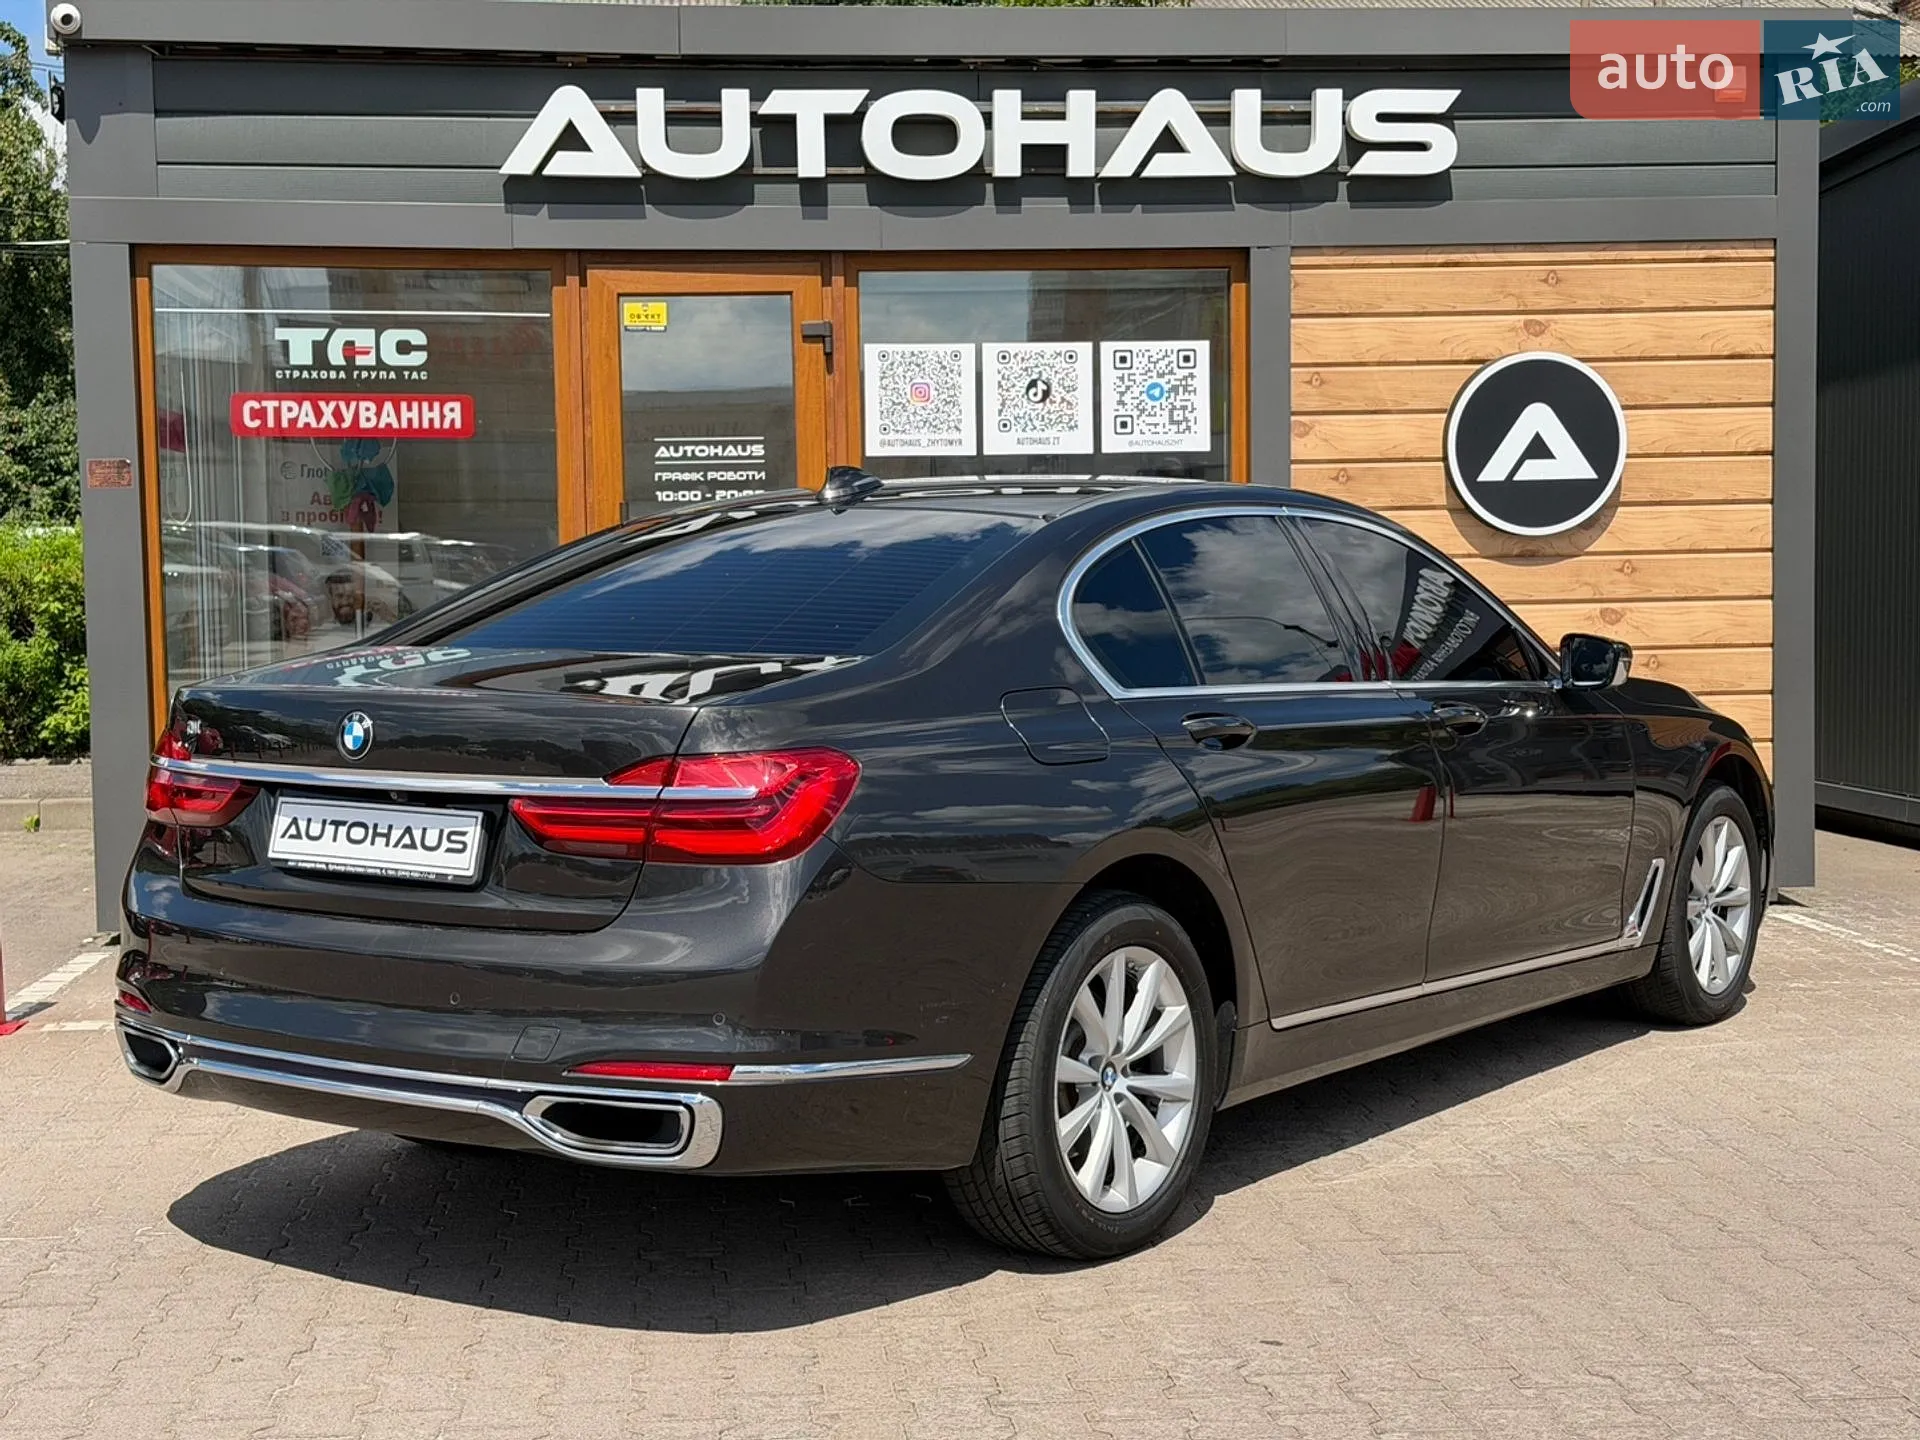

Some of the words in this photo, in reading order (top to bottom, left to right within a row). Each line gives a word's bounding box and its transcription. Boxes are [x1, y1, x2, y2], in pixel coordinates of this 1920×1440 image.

[499, 85, 1462, 180] AUTOHAUS
[274, 328, 428, 367] ТАС
[275, 370, 347, 380] СТРАХОВА
[353, 371, 397, 380] ГРУПА
[403, 371, 429, 380] ТАС
[242, 400, 462, 430] СТРАХУВАННЯ
[654, 444, 765, 457] AUTOHAUS
[654, 472, 705, 481] ГРАФІК
[707, 471, 766, 480] РОБОТИ
[655, 490, 701, 502] 10:00
[280, 816, 469, 855] AUTOHAUS
